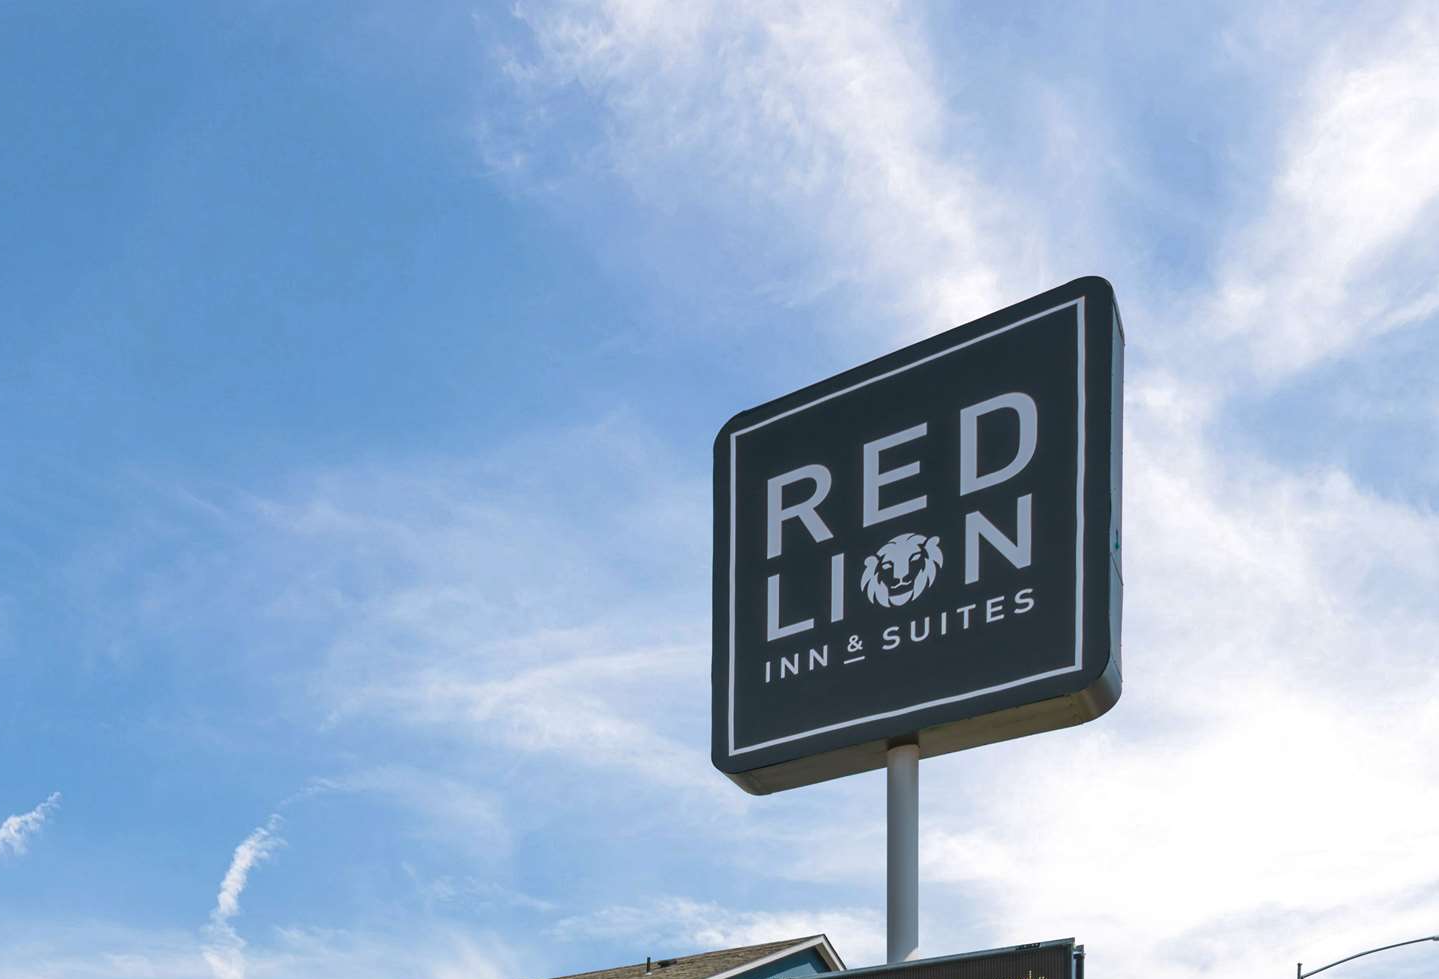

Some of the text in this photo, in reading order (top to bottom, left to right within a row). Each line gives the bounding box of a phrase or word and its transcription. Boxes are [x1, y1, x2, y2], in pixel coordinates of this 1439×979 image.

[766, 391, 1039, 561] RED
[765, 644, 829, 683] INN
[881, 588, 1035, 651] SUITES
